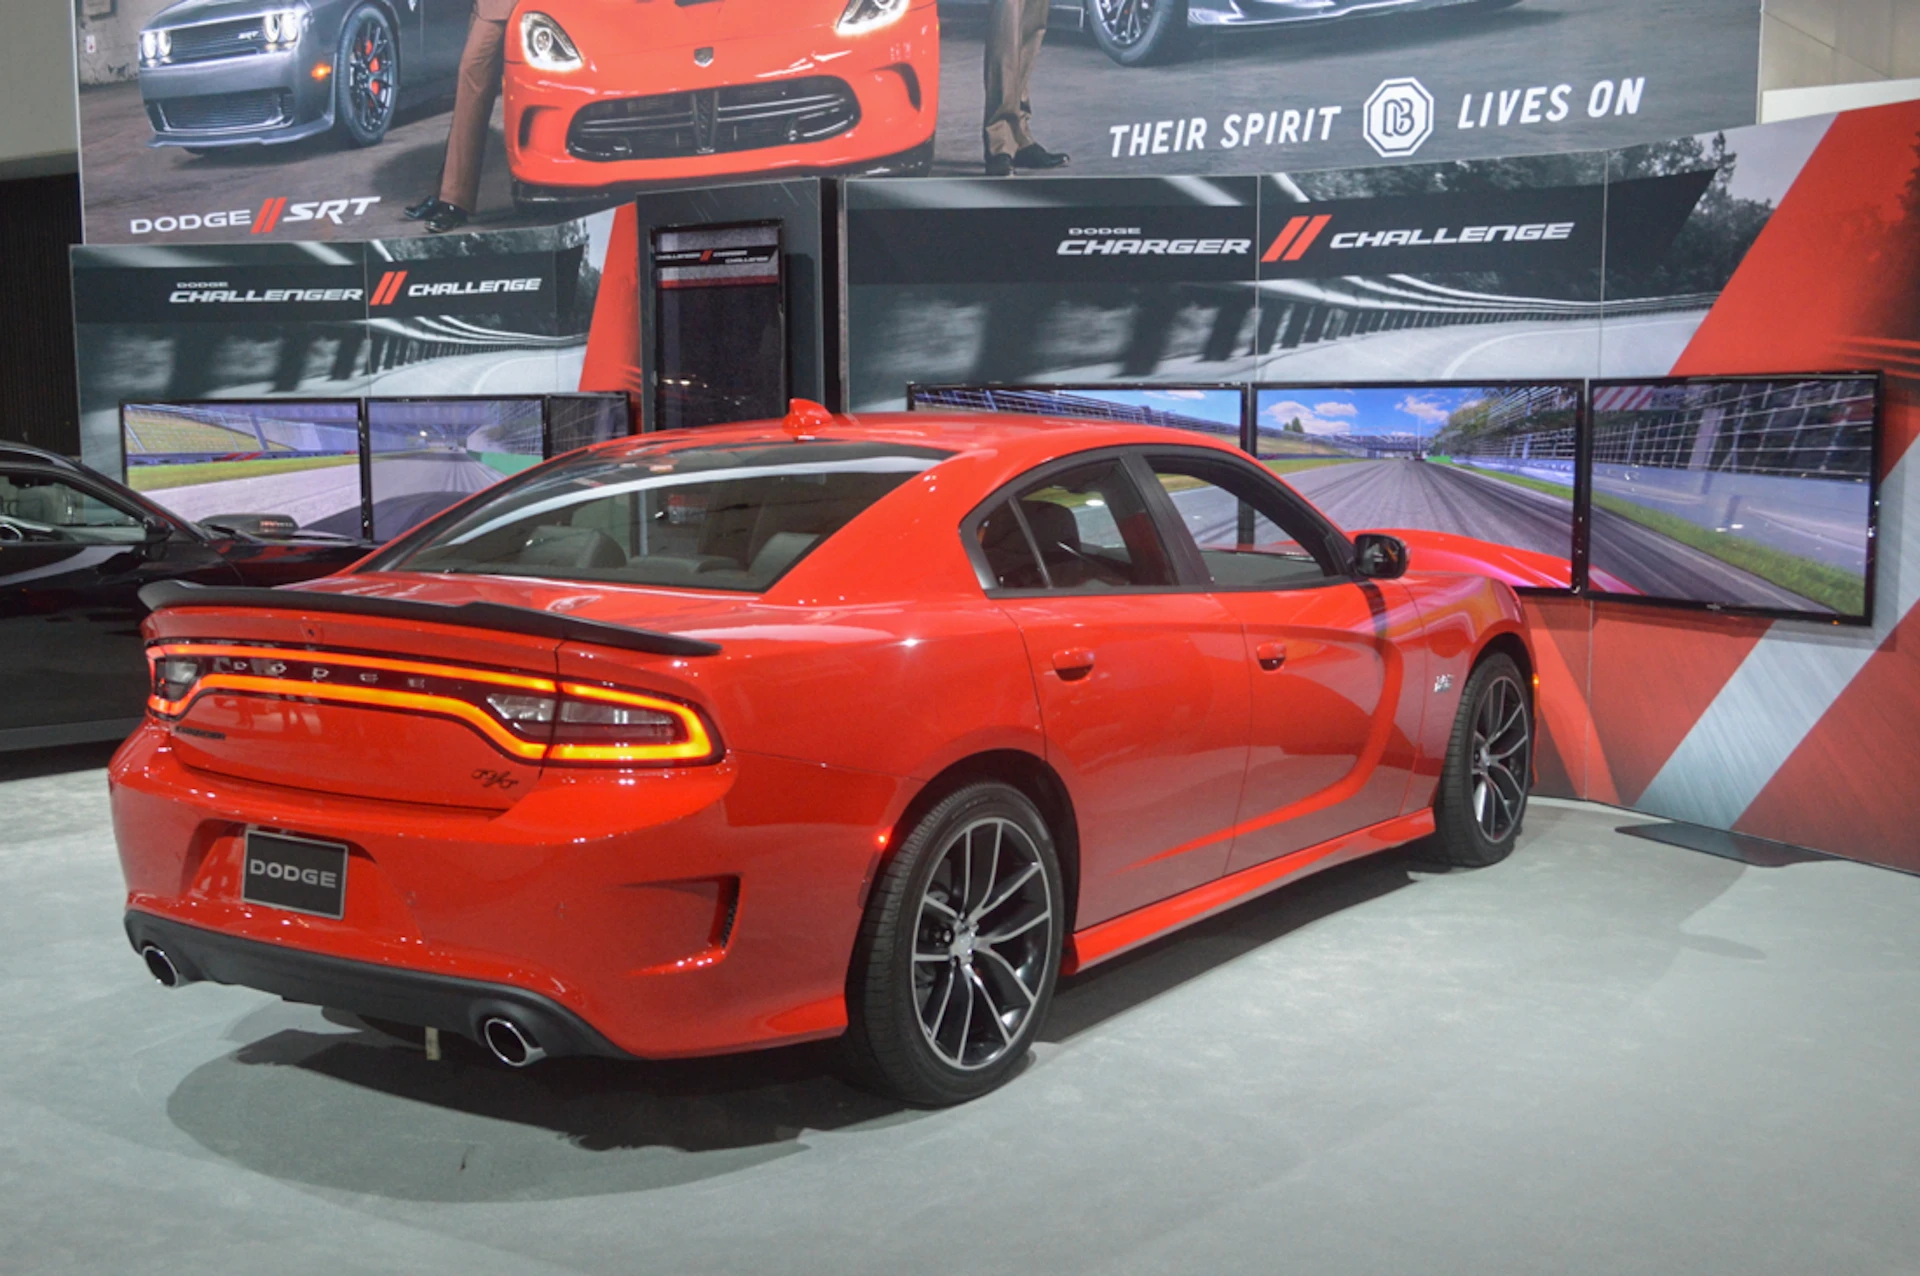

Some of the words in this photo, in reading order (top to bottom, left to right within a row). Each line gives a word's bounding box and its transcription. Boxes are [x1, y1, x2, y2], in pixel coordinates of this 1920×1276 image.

[1109, 118, 1207, 158] THEIR
[1220, 105, 1342, 149] SPIRIT
[1457, 84, 1572, 129] LIVES
[1587, 77, 1646, 118] ON
[130, 210, 252, 234] DODGE
[283, 196, 381, 225] SRT
[1056, 238, 1251, 256] CHARGER
[1330, 222, 1575, 249] CHALLENGE
[1068, 227, 1141, 236] DODGE
[169, 288, 364, 303] CHALLENGER
[408, 278, 542, 297] CHALLENGE
[176, 281, 229, 289] DODGE
[249, 858, 338, 889] DODGE
